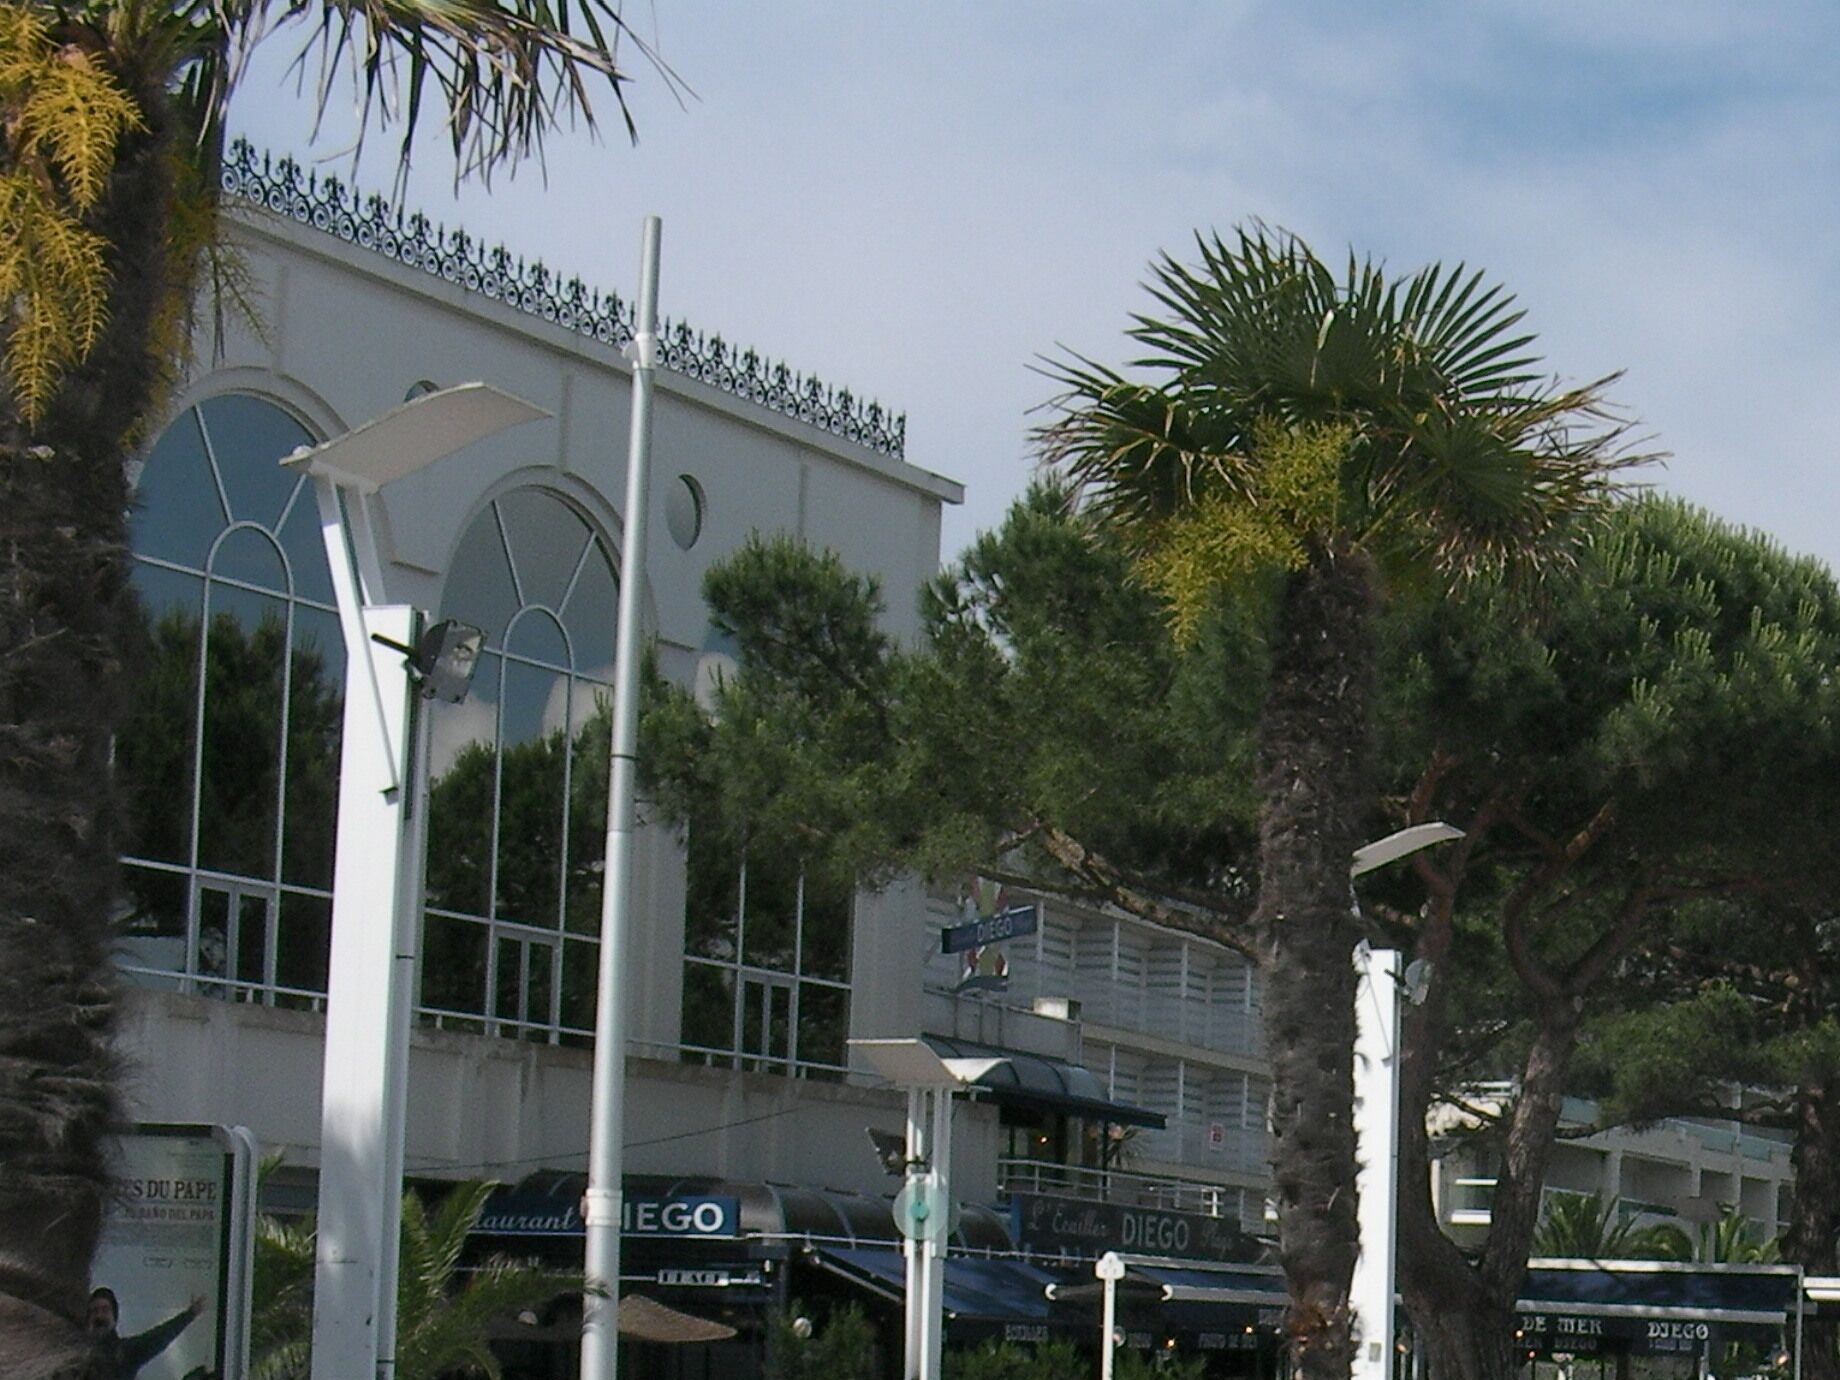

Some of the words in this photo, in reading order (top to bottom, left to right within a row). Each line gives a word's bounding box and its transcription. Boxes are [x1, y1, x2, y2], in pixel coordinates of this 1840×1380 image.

[147, 1180, 170, 1199] DU
[174, 1181, 217, 1200] PAPE
[624, 1202, 724, 1232] IEGO
[1121, 1212, 1190, 1251] DIEGO
[1522, 1315, 1547, 1332] DE
[1558, 1317, 1603, 1335] MER
[1648, 1321, 1709, 1340] DIEGO
